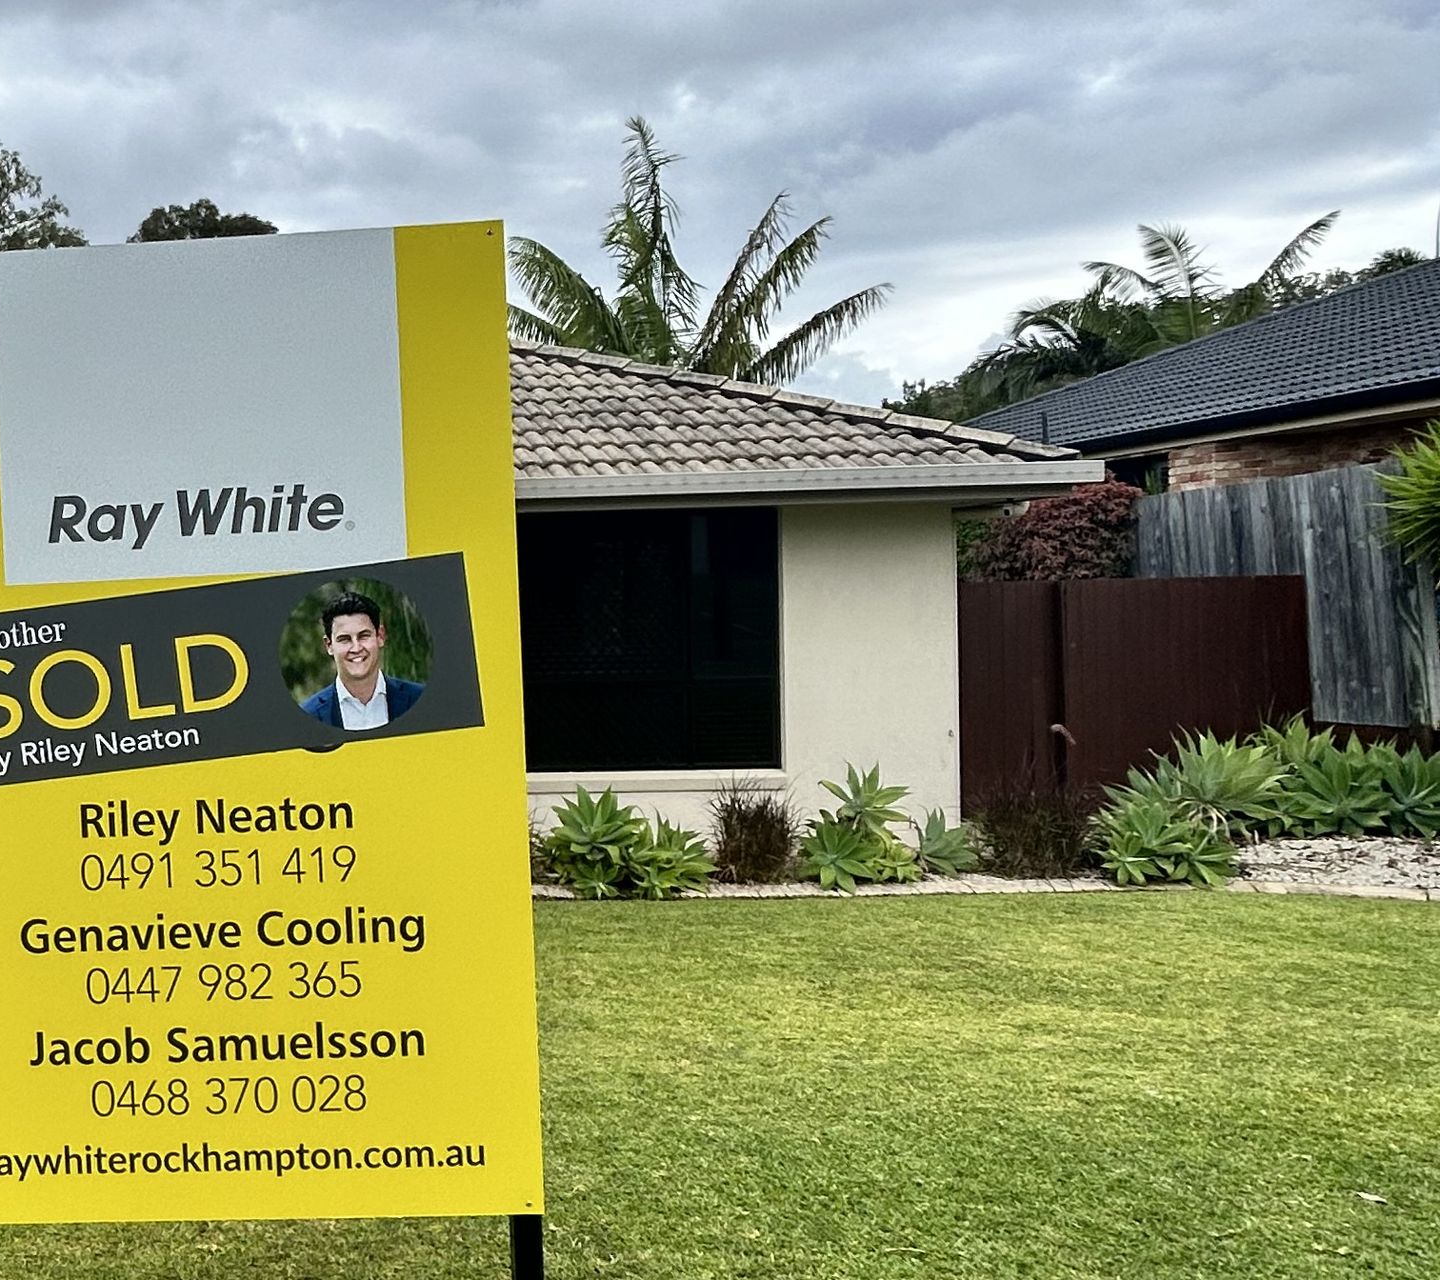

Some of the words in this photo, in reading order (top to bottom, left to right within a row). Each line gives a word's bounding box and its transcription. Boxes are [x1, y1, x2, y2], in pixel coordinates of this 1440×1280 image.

[48, 494, 163, 550] Ray
[176, 483, 345, 537] White
[20, 738, 86, 771] Riley
[95, 725, 201, 758] Neaton
[79, 800, 180, 845] Riley
[195, 798, 355, 835] Neaton
[80, 852, 175, 891] 0491
[194, 848, 262, 888] 351
[282, 845, 357, 885] 419
[19, 913, 242, 954] Genavieve
[256, 906, 426, 953] Cooling
[85, 966, 181, 1005] 0447
[198, 963, 273, 1002] 982
[288, 960, 362, 999] 365
[30, 1026, 151, 1067] Jacob
[166, 1022, 426, 1064] Samuelsson
[91, 1079, 190, 1117] 0468
[205, 1076, 279, 1115] 370
[291, 1074, 367, 1113] 028
